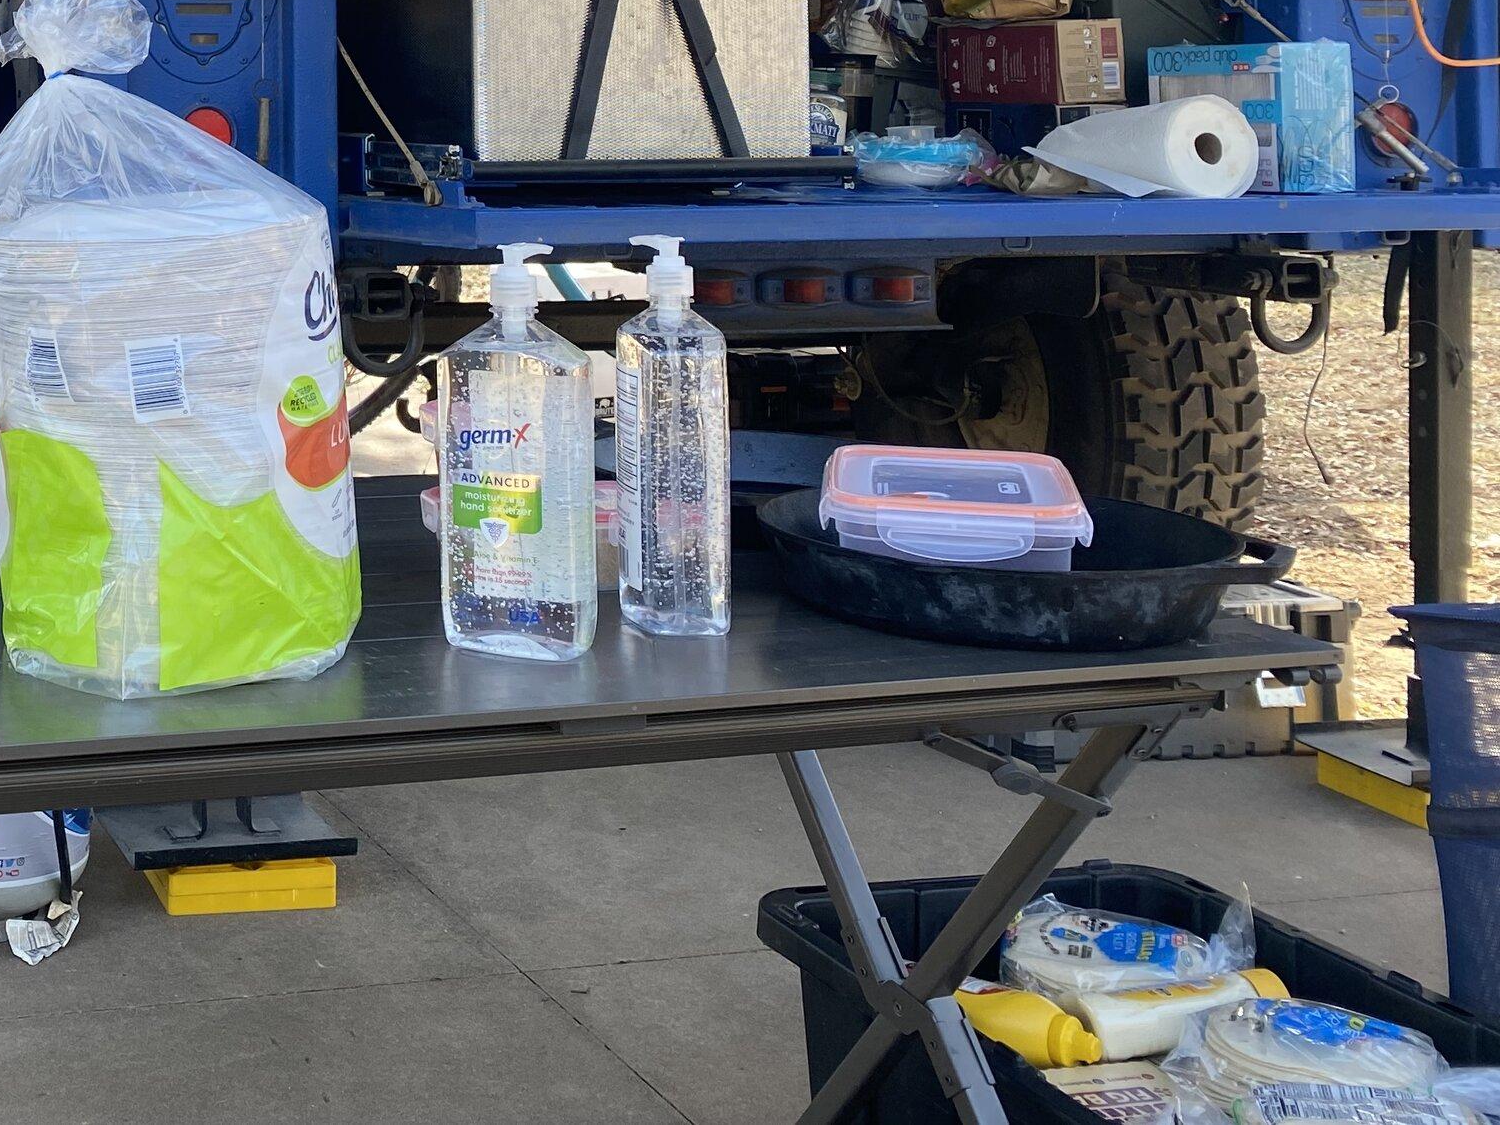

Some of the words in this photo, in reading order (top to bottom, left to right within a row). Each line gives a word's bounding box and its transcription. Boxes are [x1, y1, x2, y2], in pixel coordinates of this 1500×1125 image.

[1154, 51, 1183, 73] 300
[1246, 103, 1274, 119] 300
[461, 473, 530, 488] ADVANCED
[460, 500, 485, 512] hand
[1105, 1088, 1154, 1103] FIG
